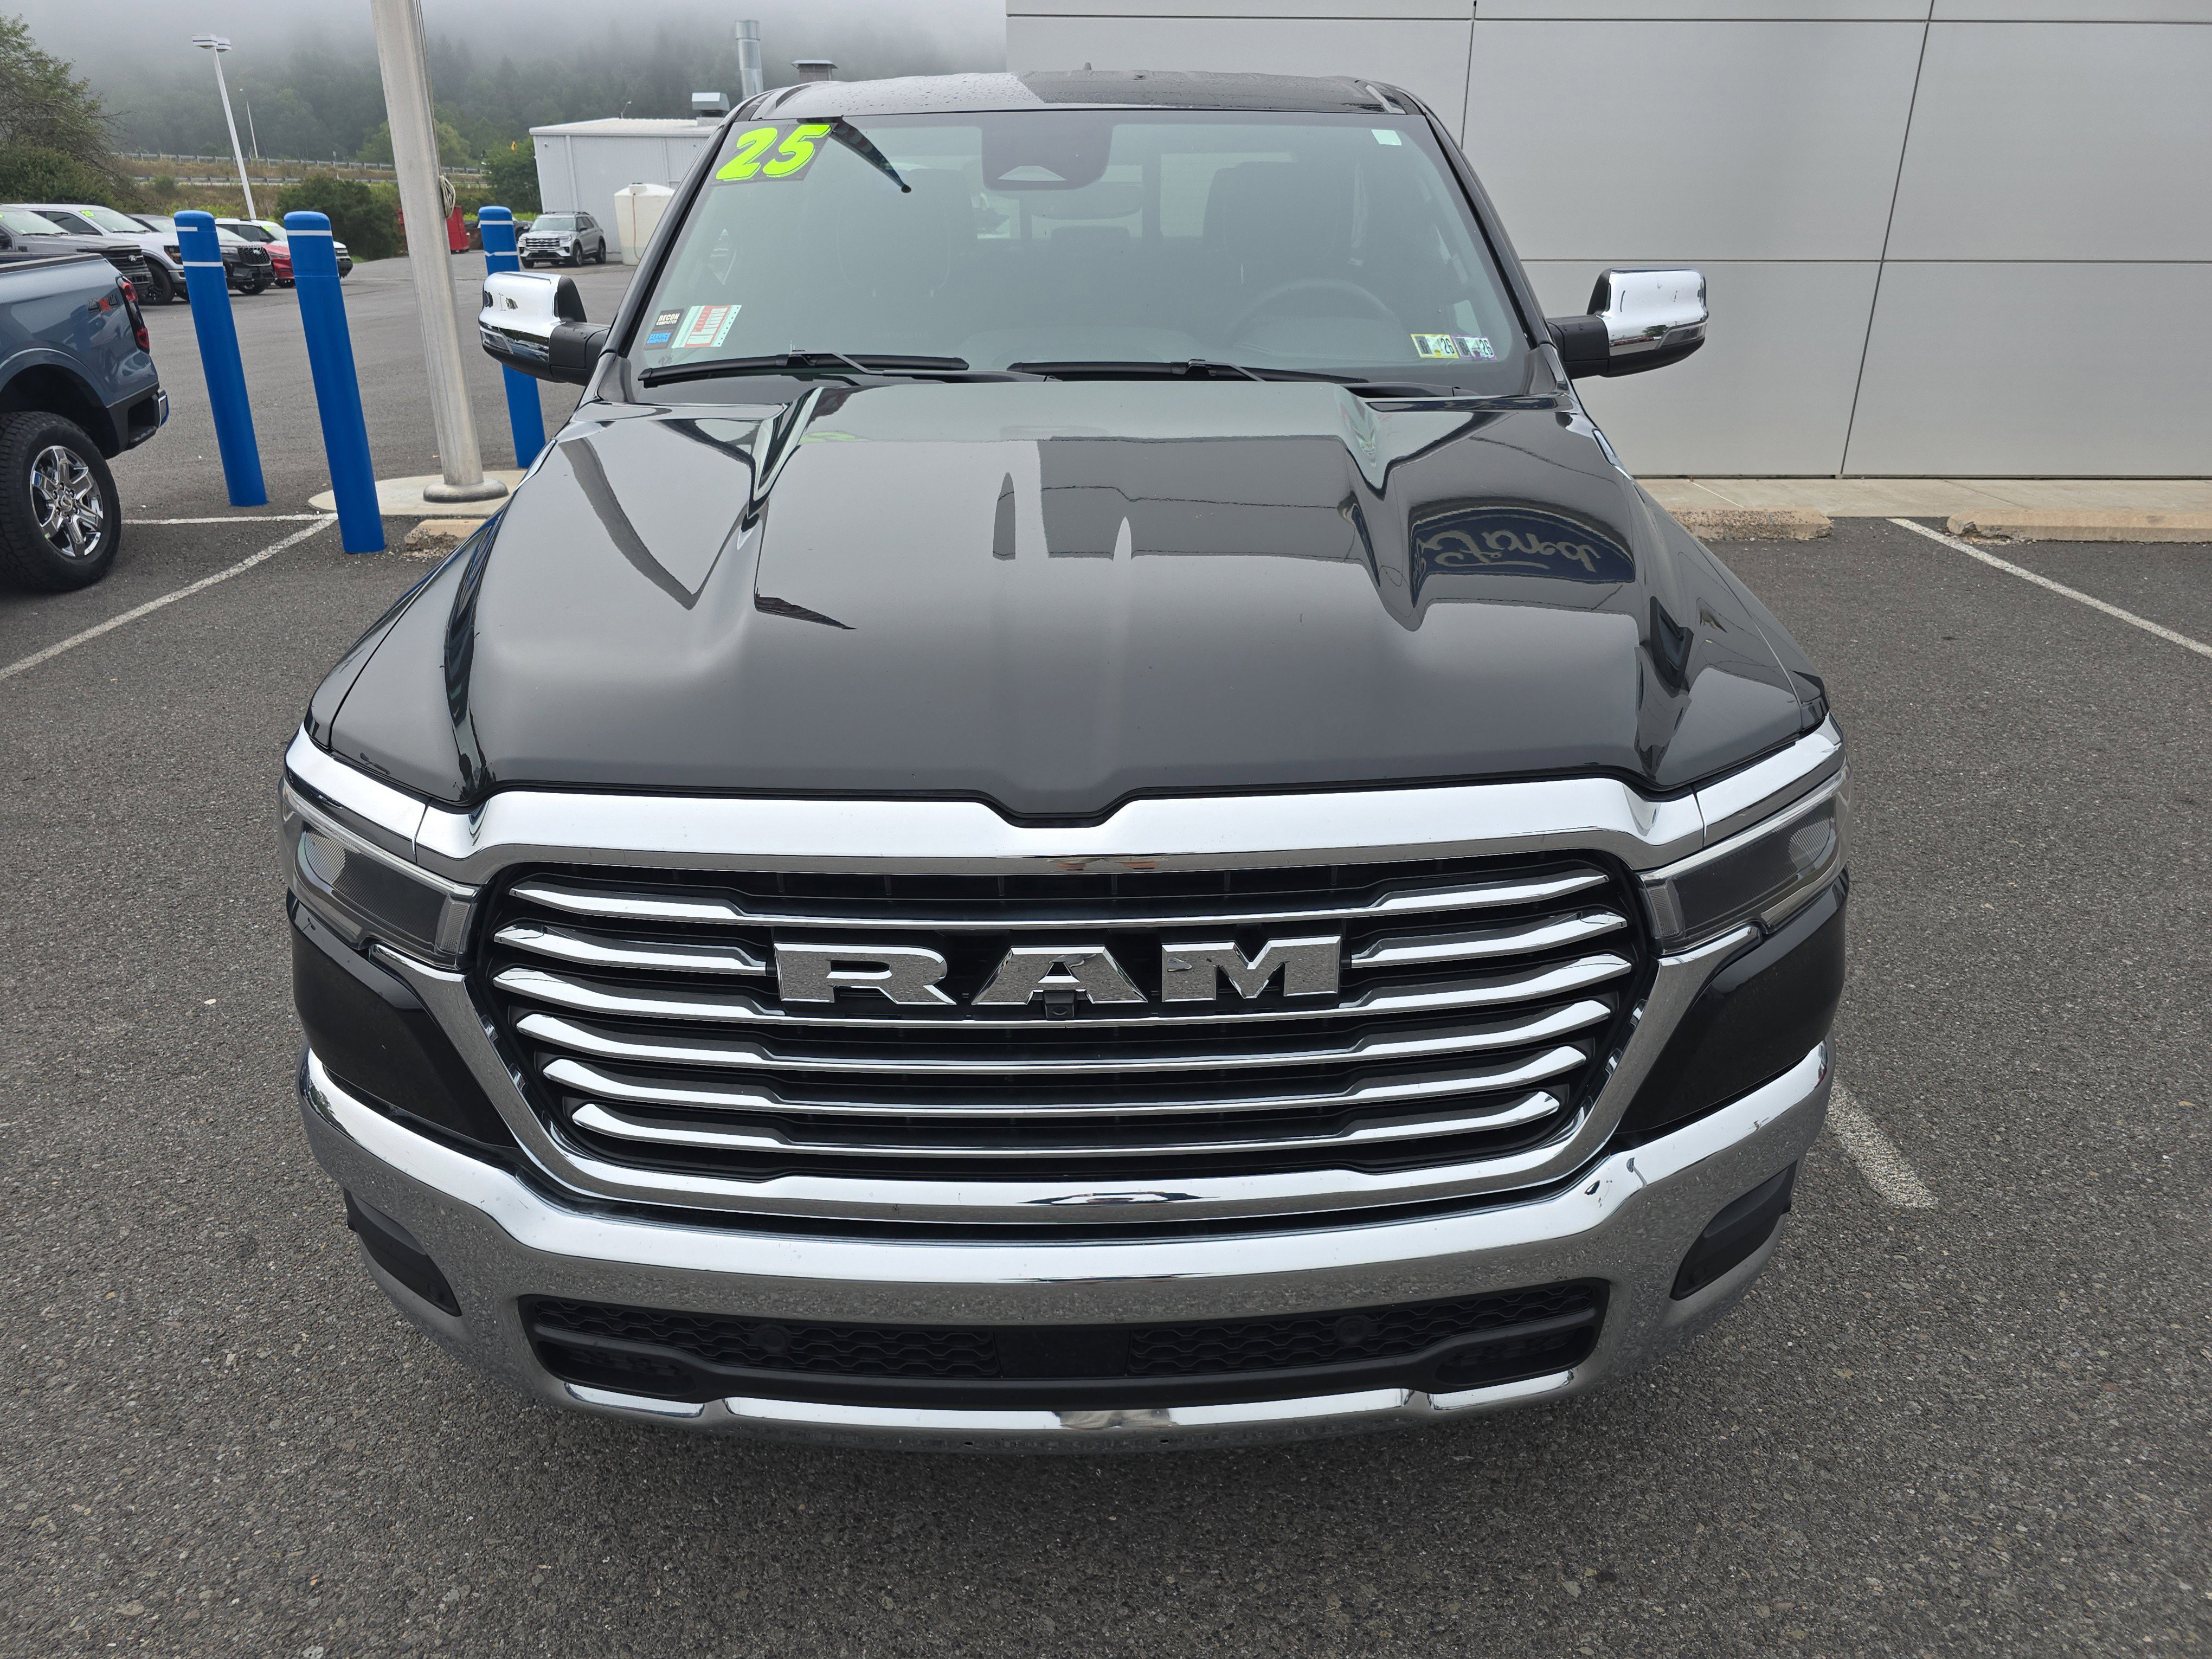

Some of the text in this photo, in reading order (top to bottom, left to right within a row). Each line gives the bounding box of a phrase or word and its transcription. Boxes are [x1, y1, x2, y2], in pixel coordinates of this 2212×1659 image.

[716, 124, 832, 182] 25
[658, 313, 680, 322] RECON
[1440, 338, 1455, 354] 26
[1479, 339, 1493, 356] 26
[774, 935, 1342, 1006] RAM
